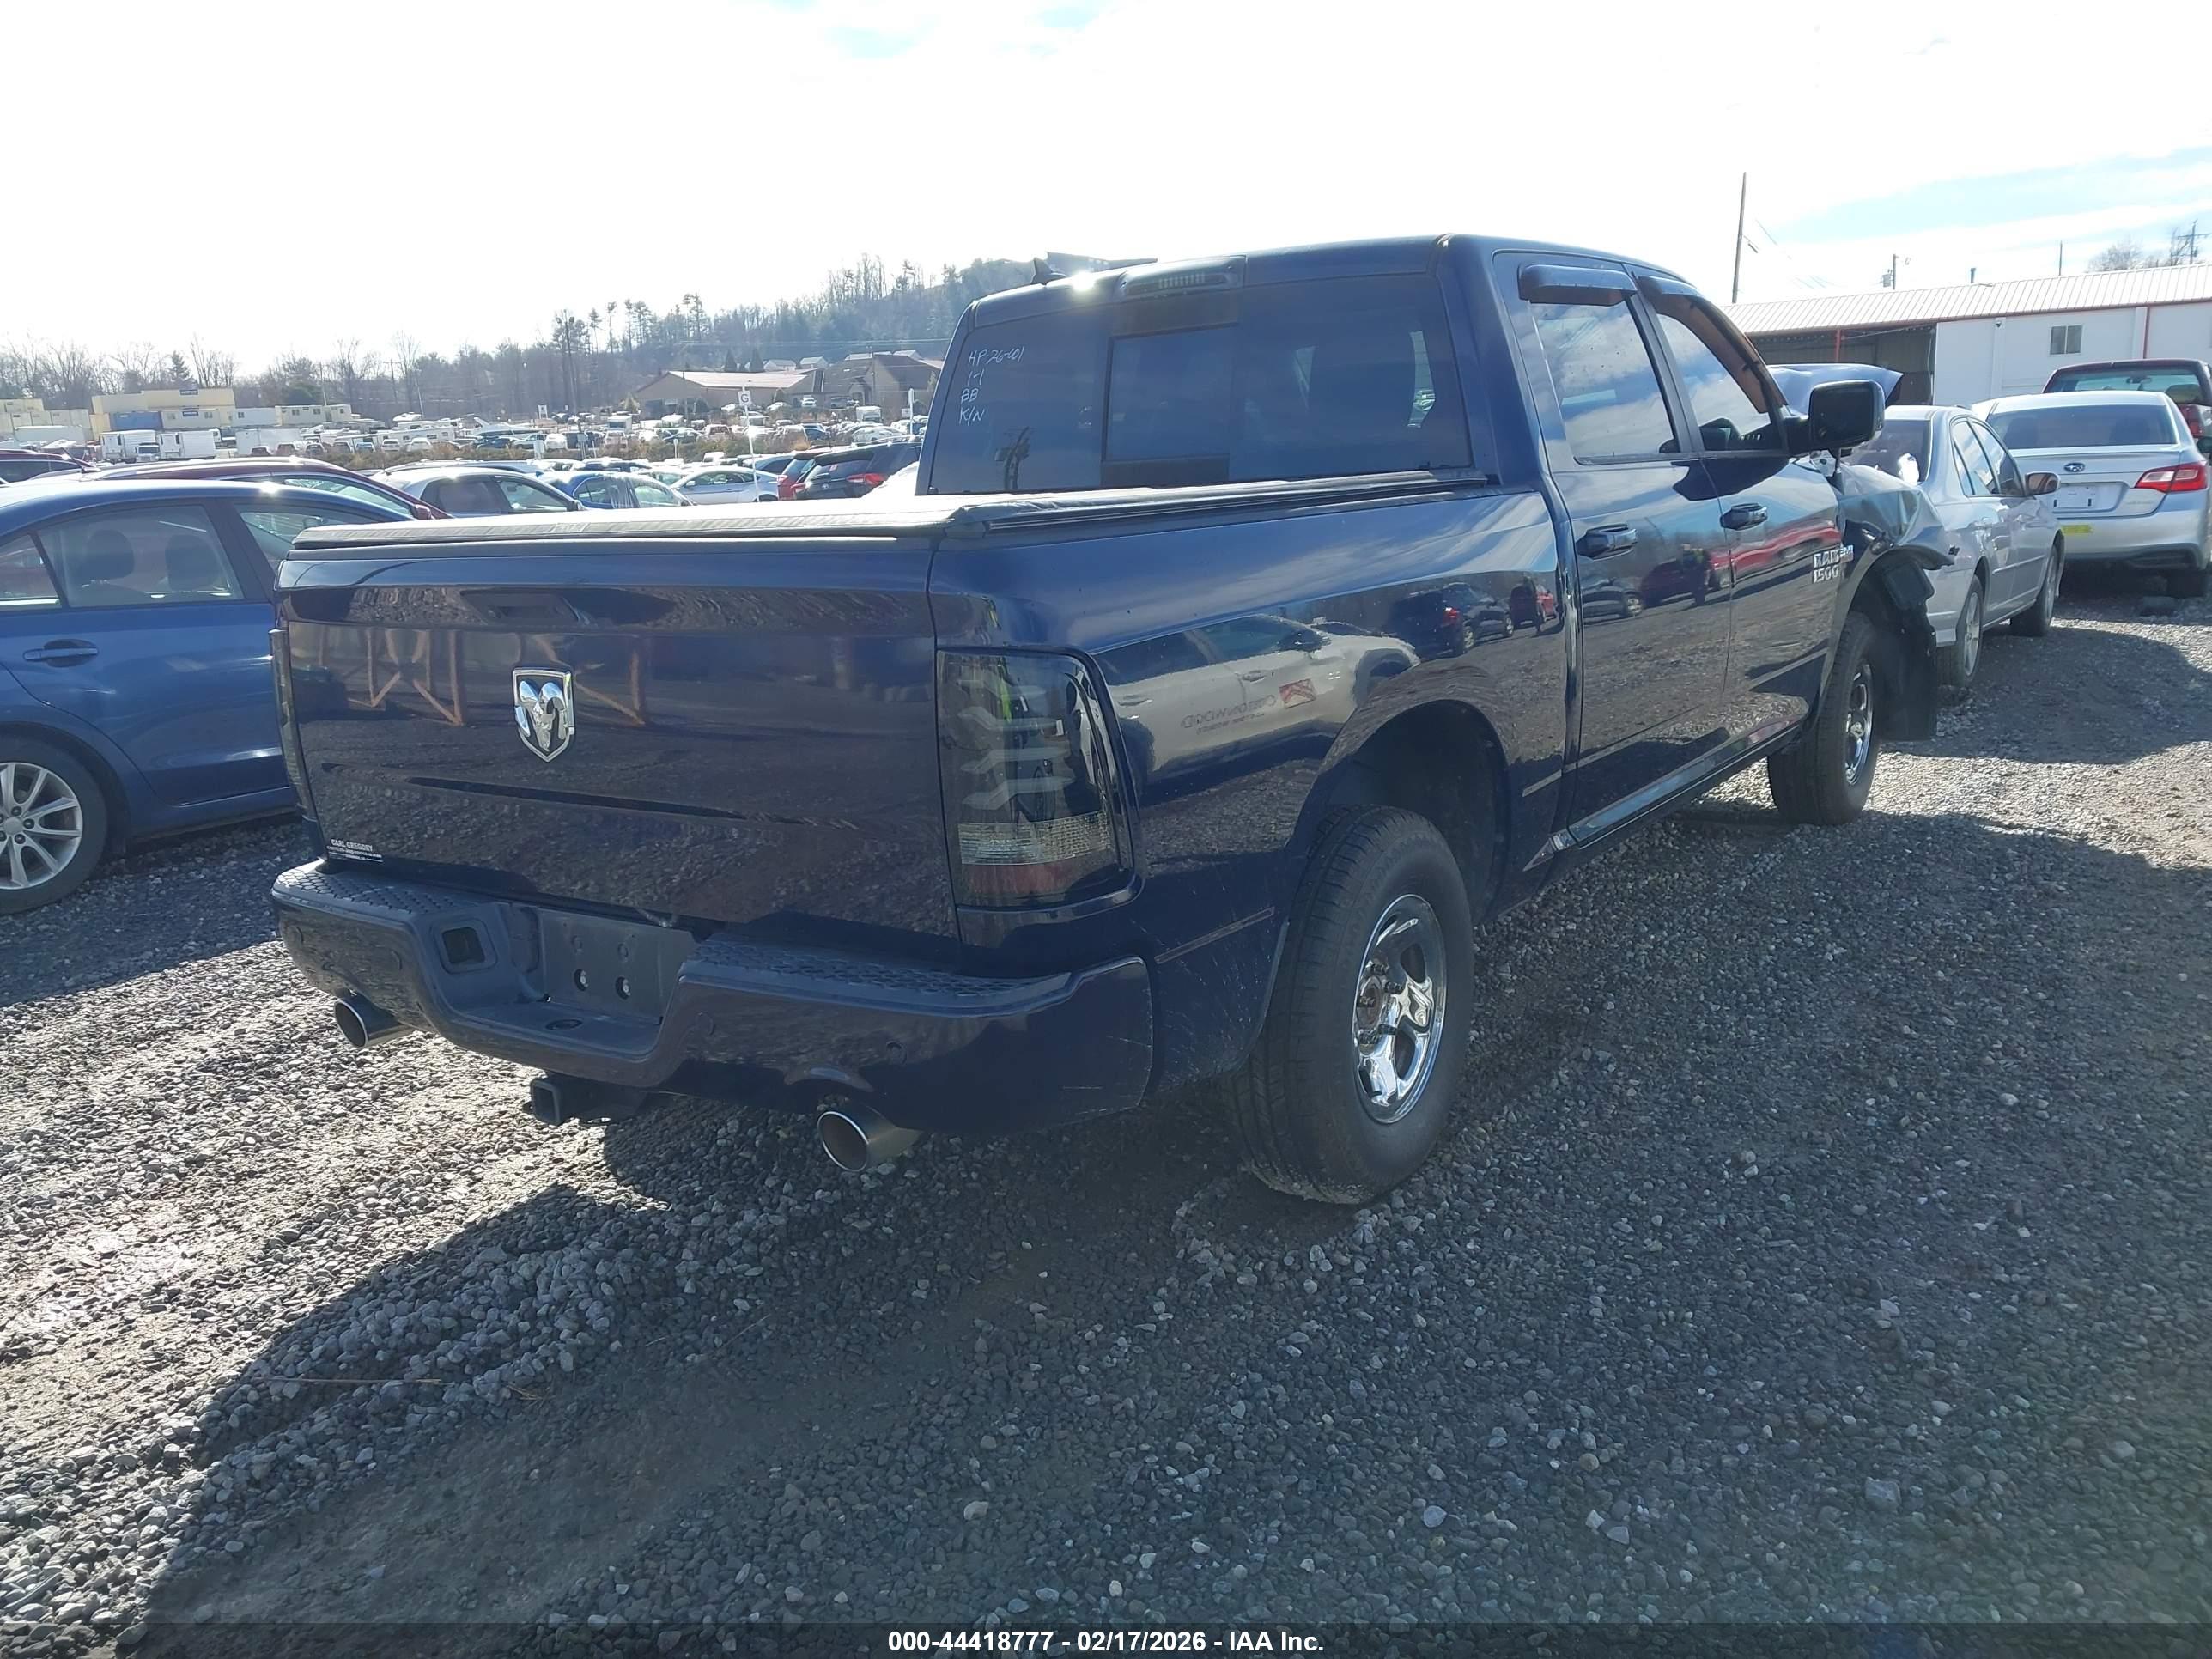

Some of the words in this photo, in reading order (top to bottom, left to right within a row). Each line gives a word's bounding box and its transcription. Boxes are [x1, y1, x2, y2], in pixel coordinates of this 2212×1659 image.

[740, 393, 750, 403] G
[1813, 564, 1839, 584] 1500
[331, 839, 346, 848] CARL
[346, 842, 373, 852] GREGORY
